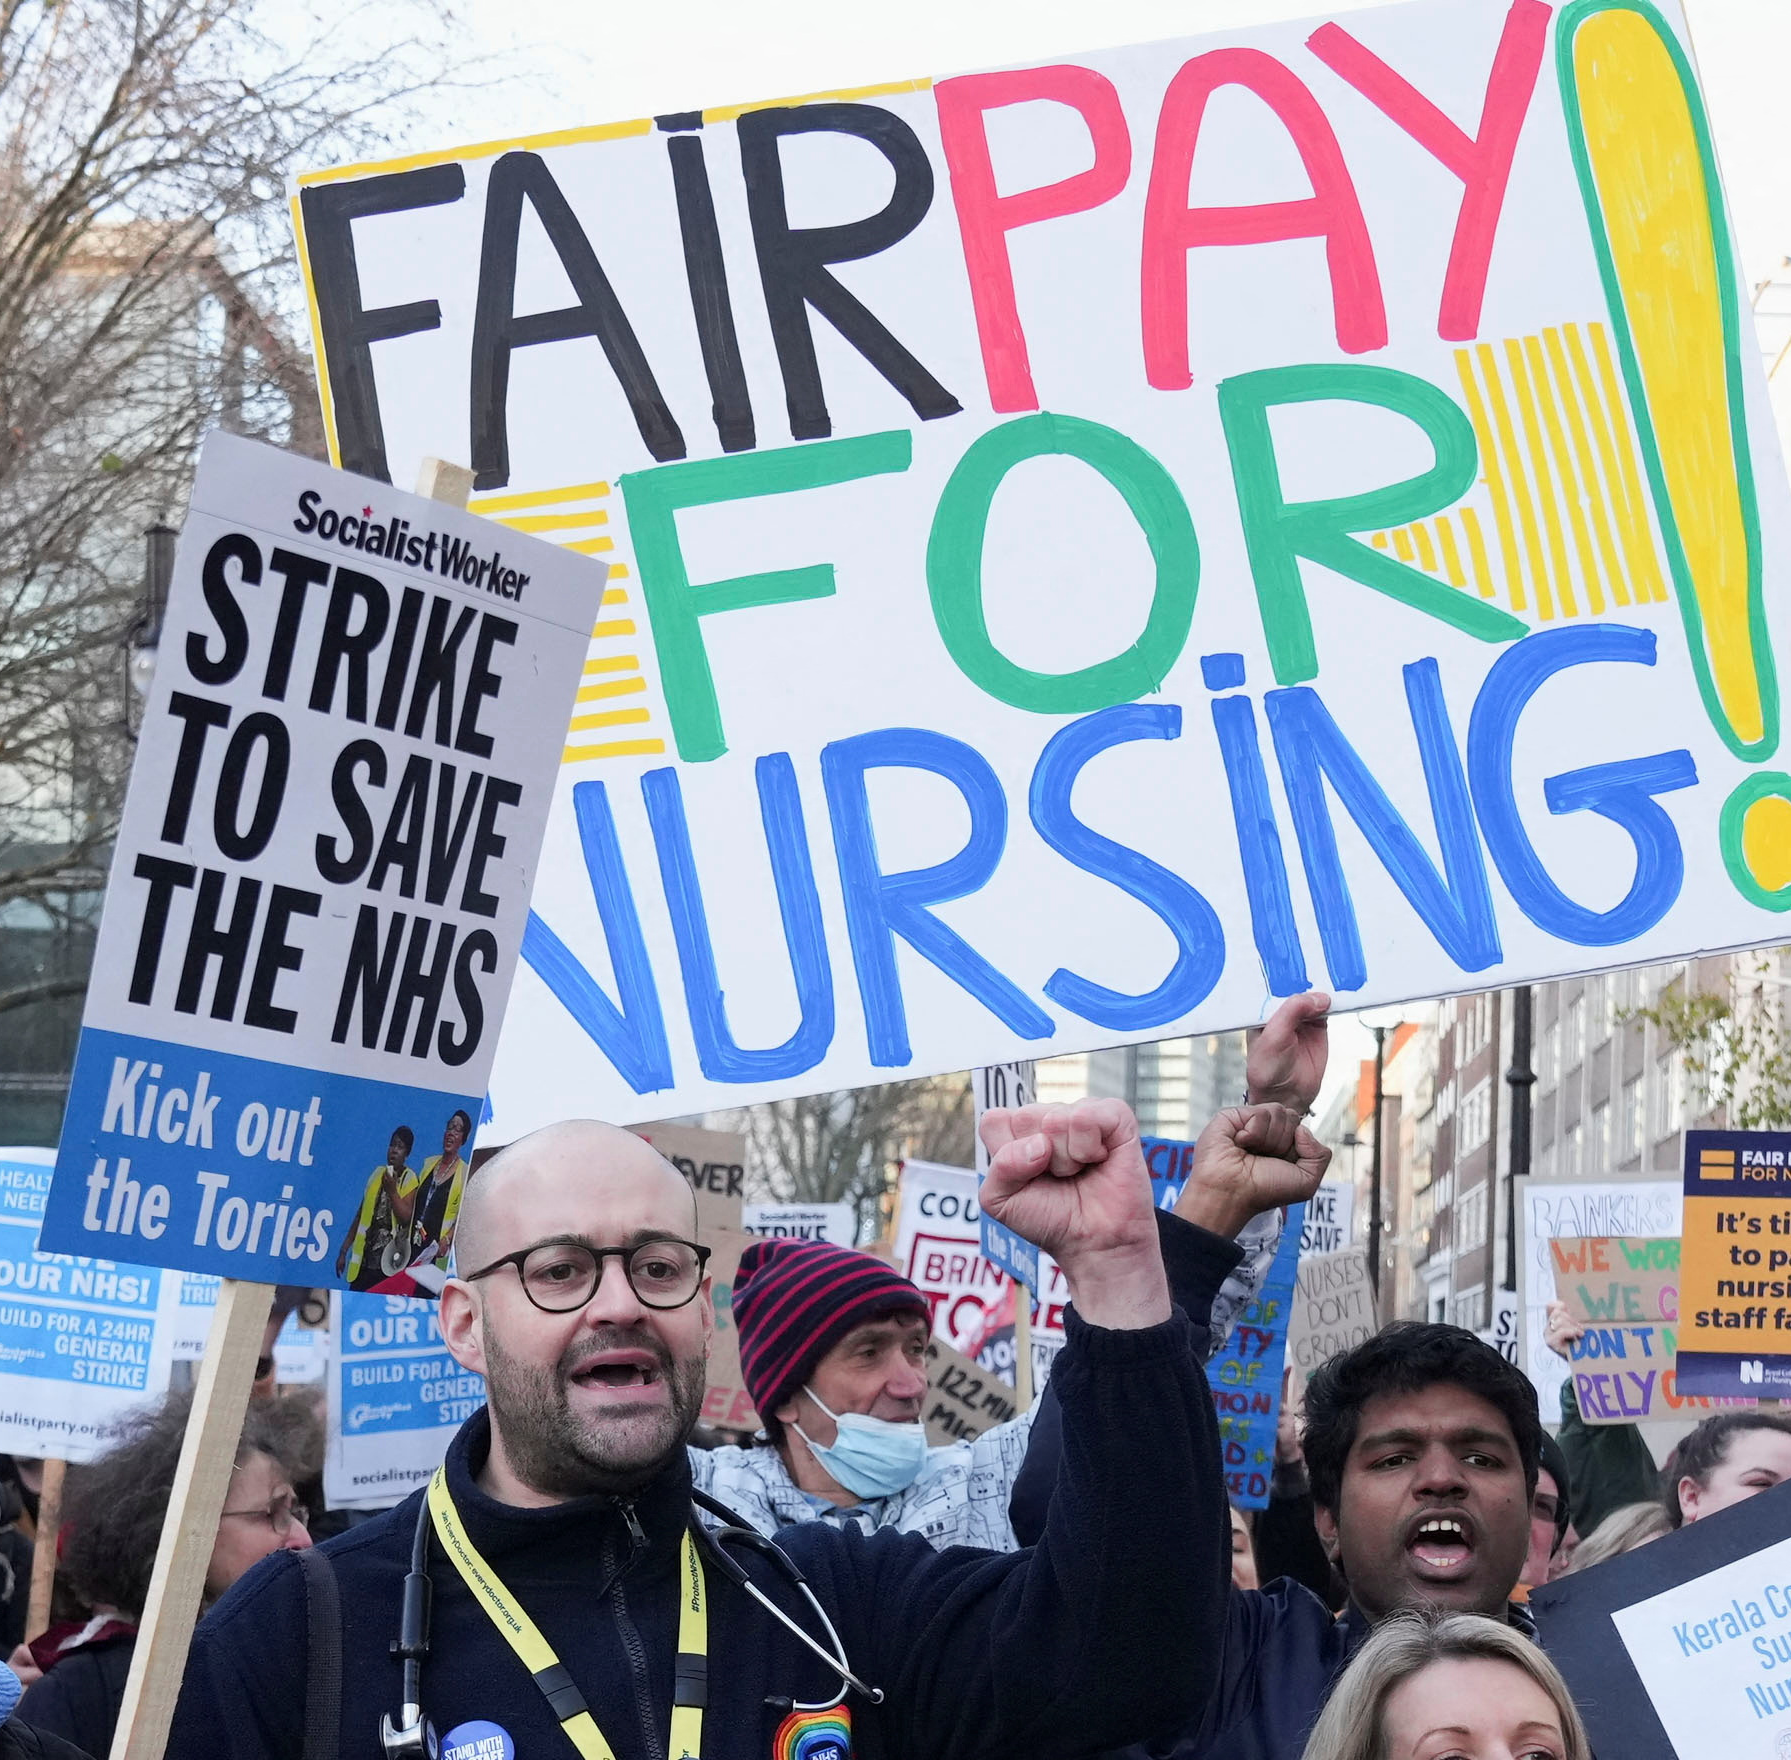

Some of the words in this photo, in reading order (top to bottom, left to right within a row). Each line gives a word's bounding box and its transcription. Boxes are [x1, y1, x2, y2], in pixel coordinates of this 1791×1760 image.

[299, 102, 963, 491] FAIR
[933, 0, 1552, 412] PAY
[293, 490, 438, 575] Socialist
[438, 535, 530, 604] Worker
[618, 361, 1530, 762] FOR
[185, 533, 519, 760] STRIKE
[159, 690, 292, 862] TO
[314, 738, 522, 919] SAVE
[127, 854, 322, 1035] THE
[331, 904, 498, 1067] NHS
[101, 1056, 222, 1150] Kick
[235, 1095, 323, 1168] out
[1742, 1151, 1784, 1166] FAIR
[1742, 1167, 1778, 1181] FOR
[82, 1156, 171, 1240] the
[193, 1169, 333, 1262] Tories
[1534, 1195, 1674, 1237] BANKERS
[1716, 1212, 1761, 1234] It's
[1552, 1239, 1610, 1274] WE
[1730, 1245, 1760, 1265] to
[70, 1268, 151, 1305] NHS!
[1296, 1255, 1364, 1301] NURSES
[1307, 1291, 1362, 1330] DON'T
[1577, 1283, 1643, 1321] WE
[1695, 1308, 1767, 1329] staff
[46, 1313, 80, 1334] FOR
[85, 1318, 97, 1337] A
[101, 1322, 152, 1343] 24HR
[350, 1315, 419, 1348] OUR
[1569, 1328, 1653, 1361] DON'T
[54, 1335, 147, 1365] GENERAL
[71, 1360, 147, 1389] STRIKE
[351, 1364, 404, 1387] BUILD
[409, 1361, 442, 1381] FOR
[1576, 1369, 1656, 1419] RELY
[1672, 1599, 1766, 1657] Kerala
[476, 1735, 503, 1754] WITH
